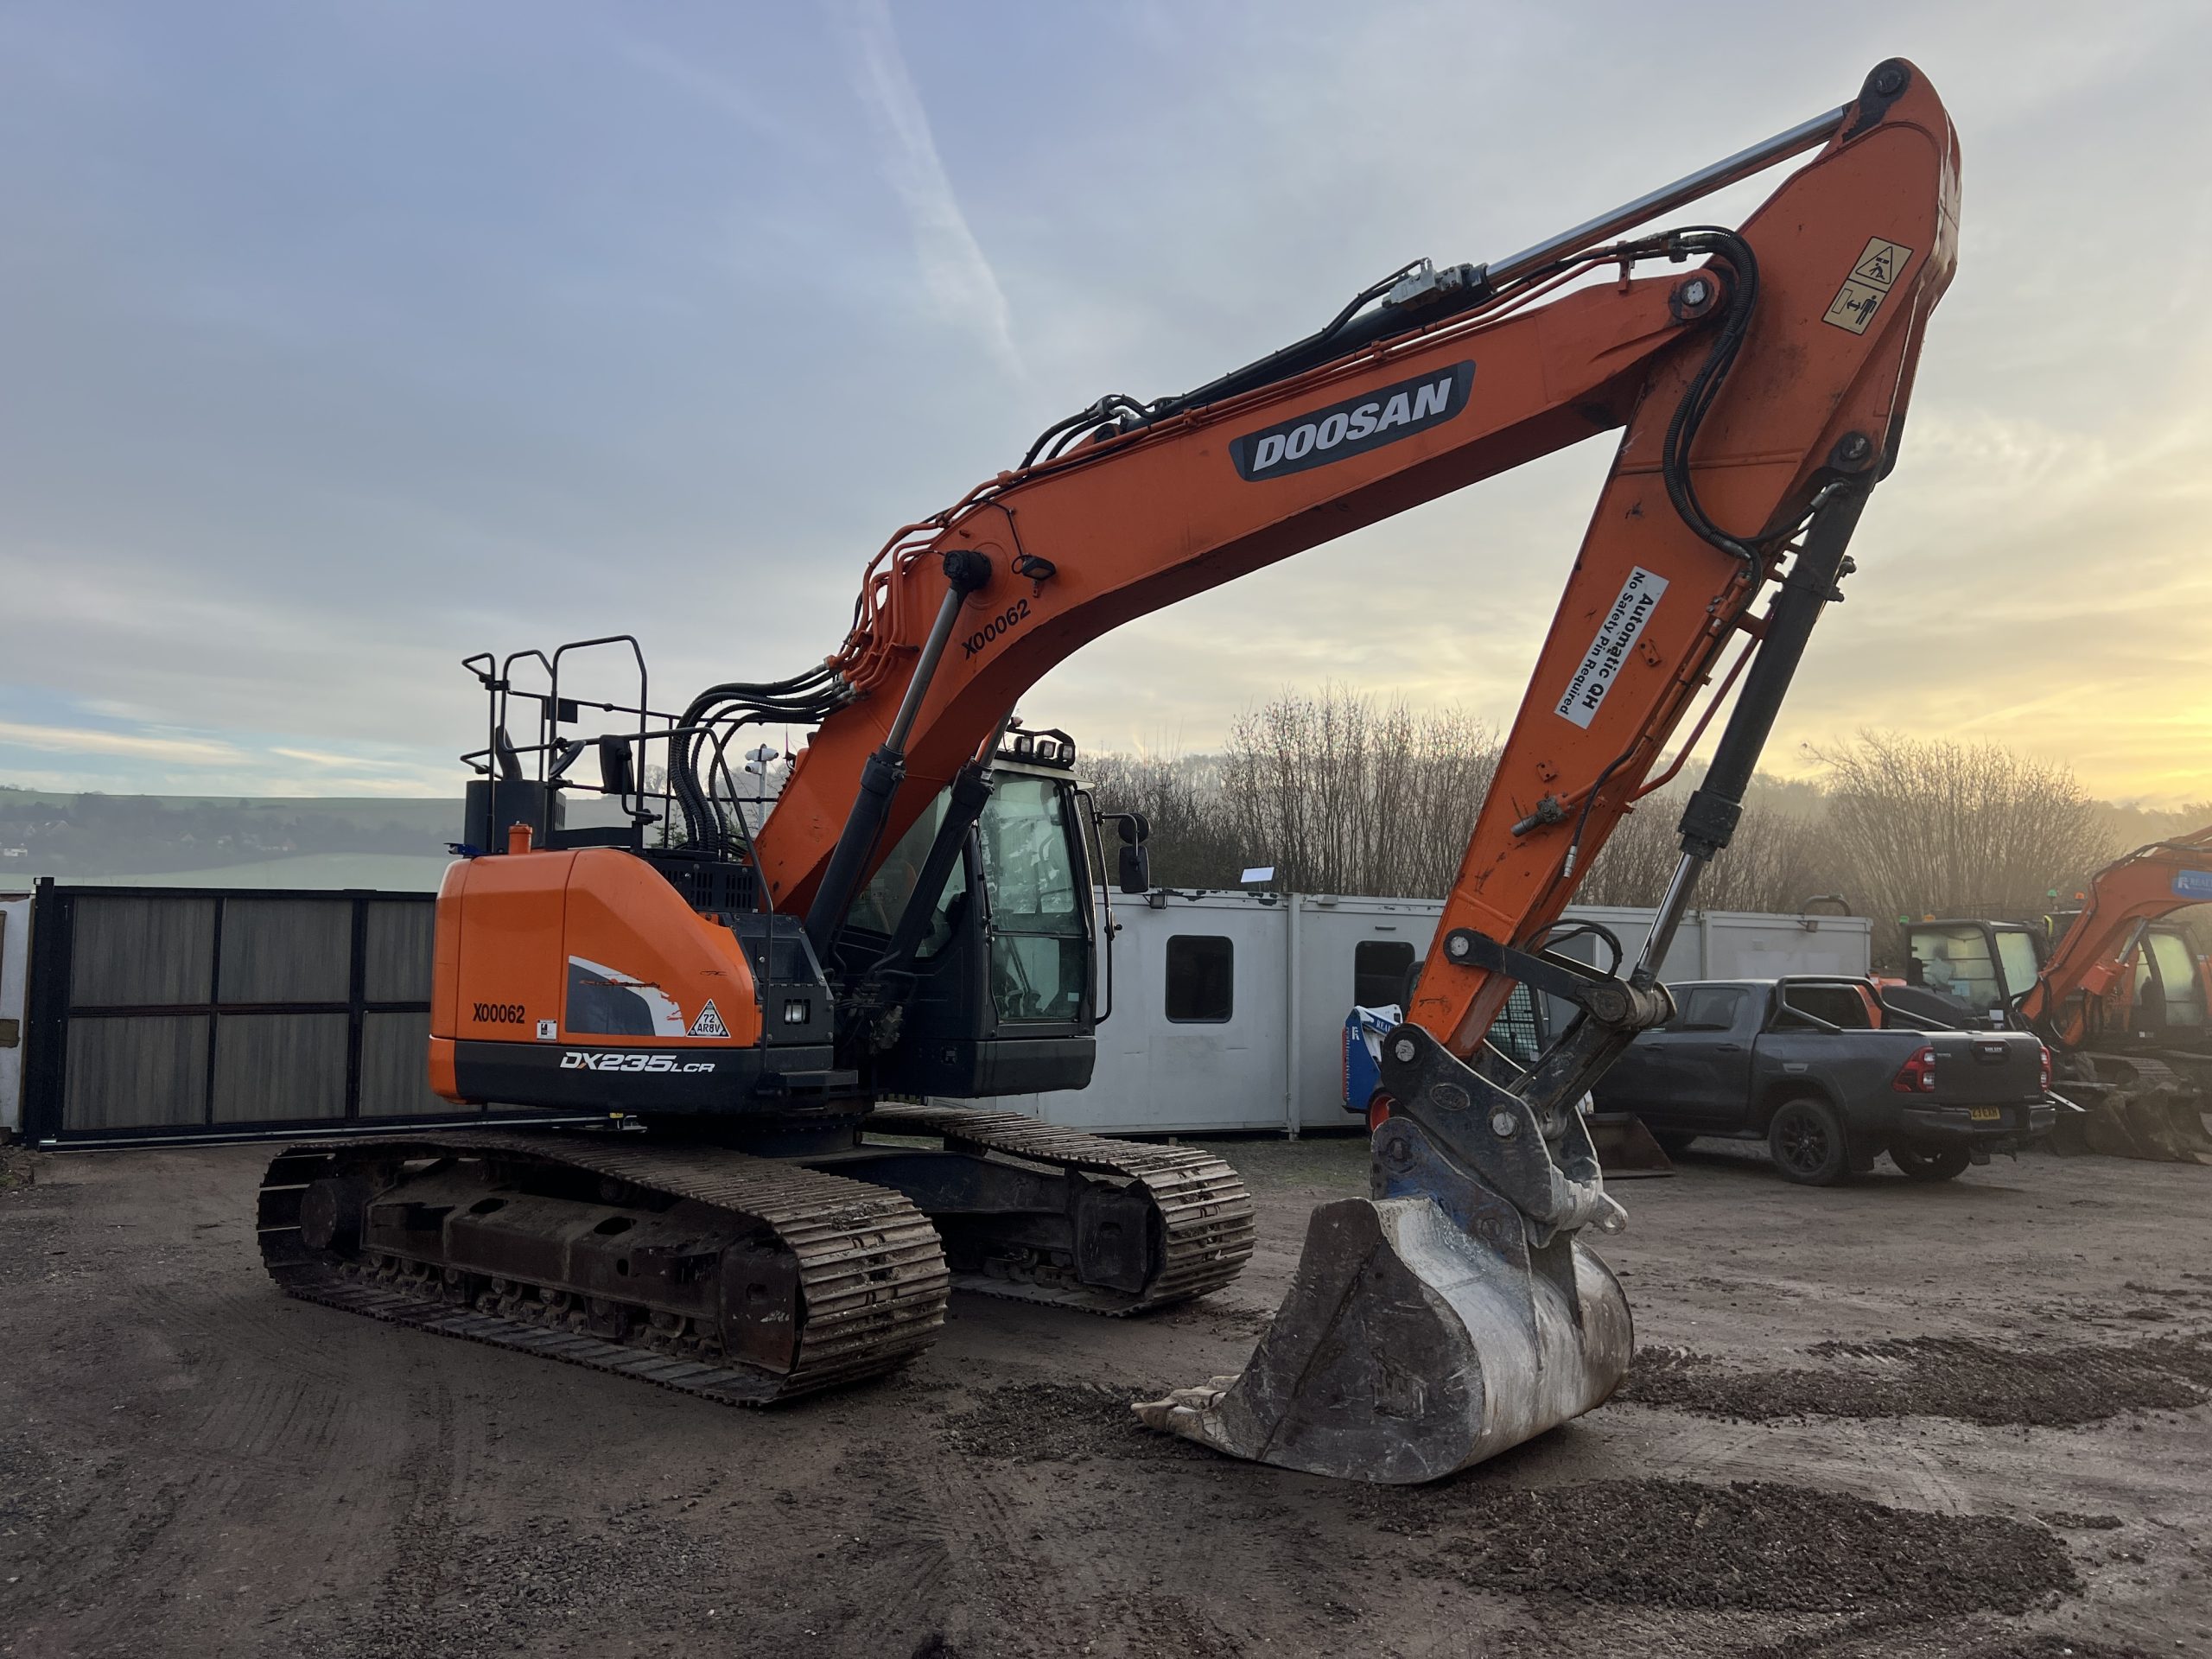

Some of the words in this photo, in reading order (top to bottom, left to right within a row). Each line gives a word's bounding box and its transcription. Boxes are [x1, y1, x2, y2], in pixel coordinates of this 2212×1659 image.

[1253, 378, 1452, 473] DOOSAN
[1629, 571, 1646, 589] No
[1604, 593, 1634, 633] Safety
[961, 599, 1031, 660] X00062
[1599, 593, 1654, 678] Automatic
[1592, 635, 1610, 657] Pin
[1560, 658, 1597, 715] Required
[1581, 683, 1605, 710] QH
[472, 1002, 525, 1024] X00062
[703, 1014, 715, 1023] 72
[697, 1023, 721, 1033] AR8V
